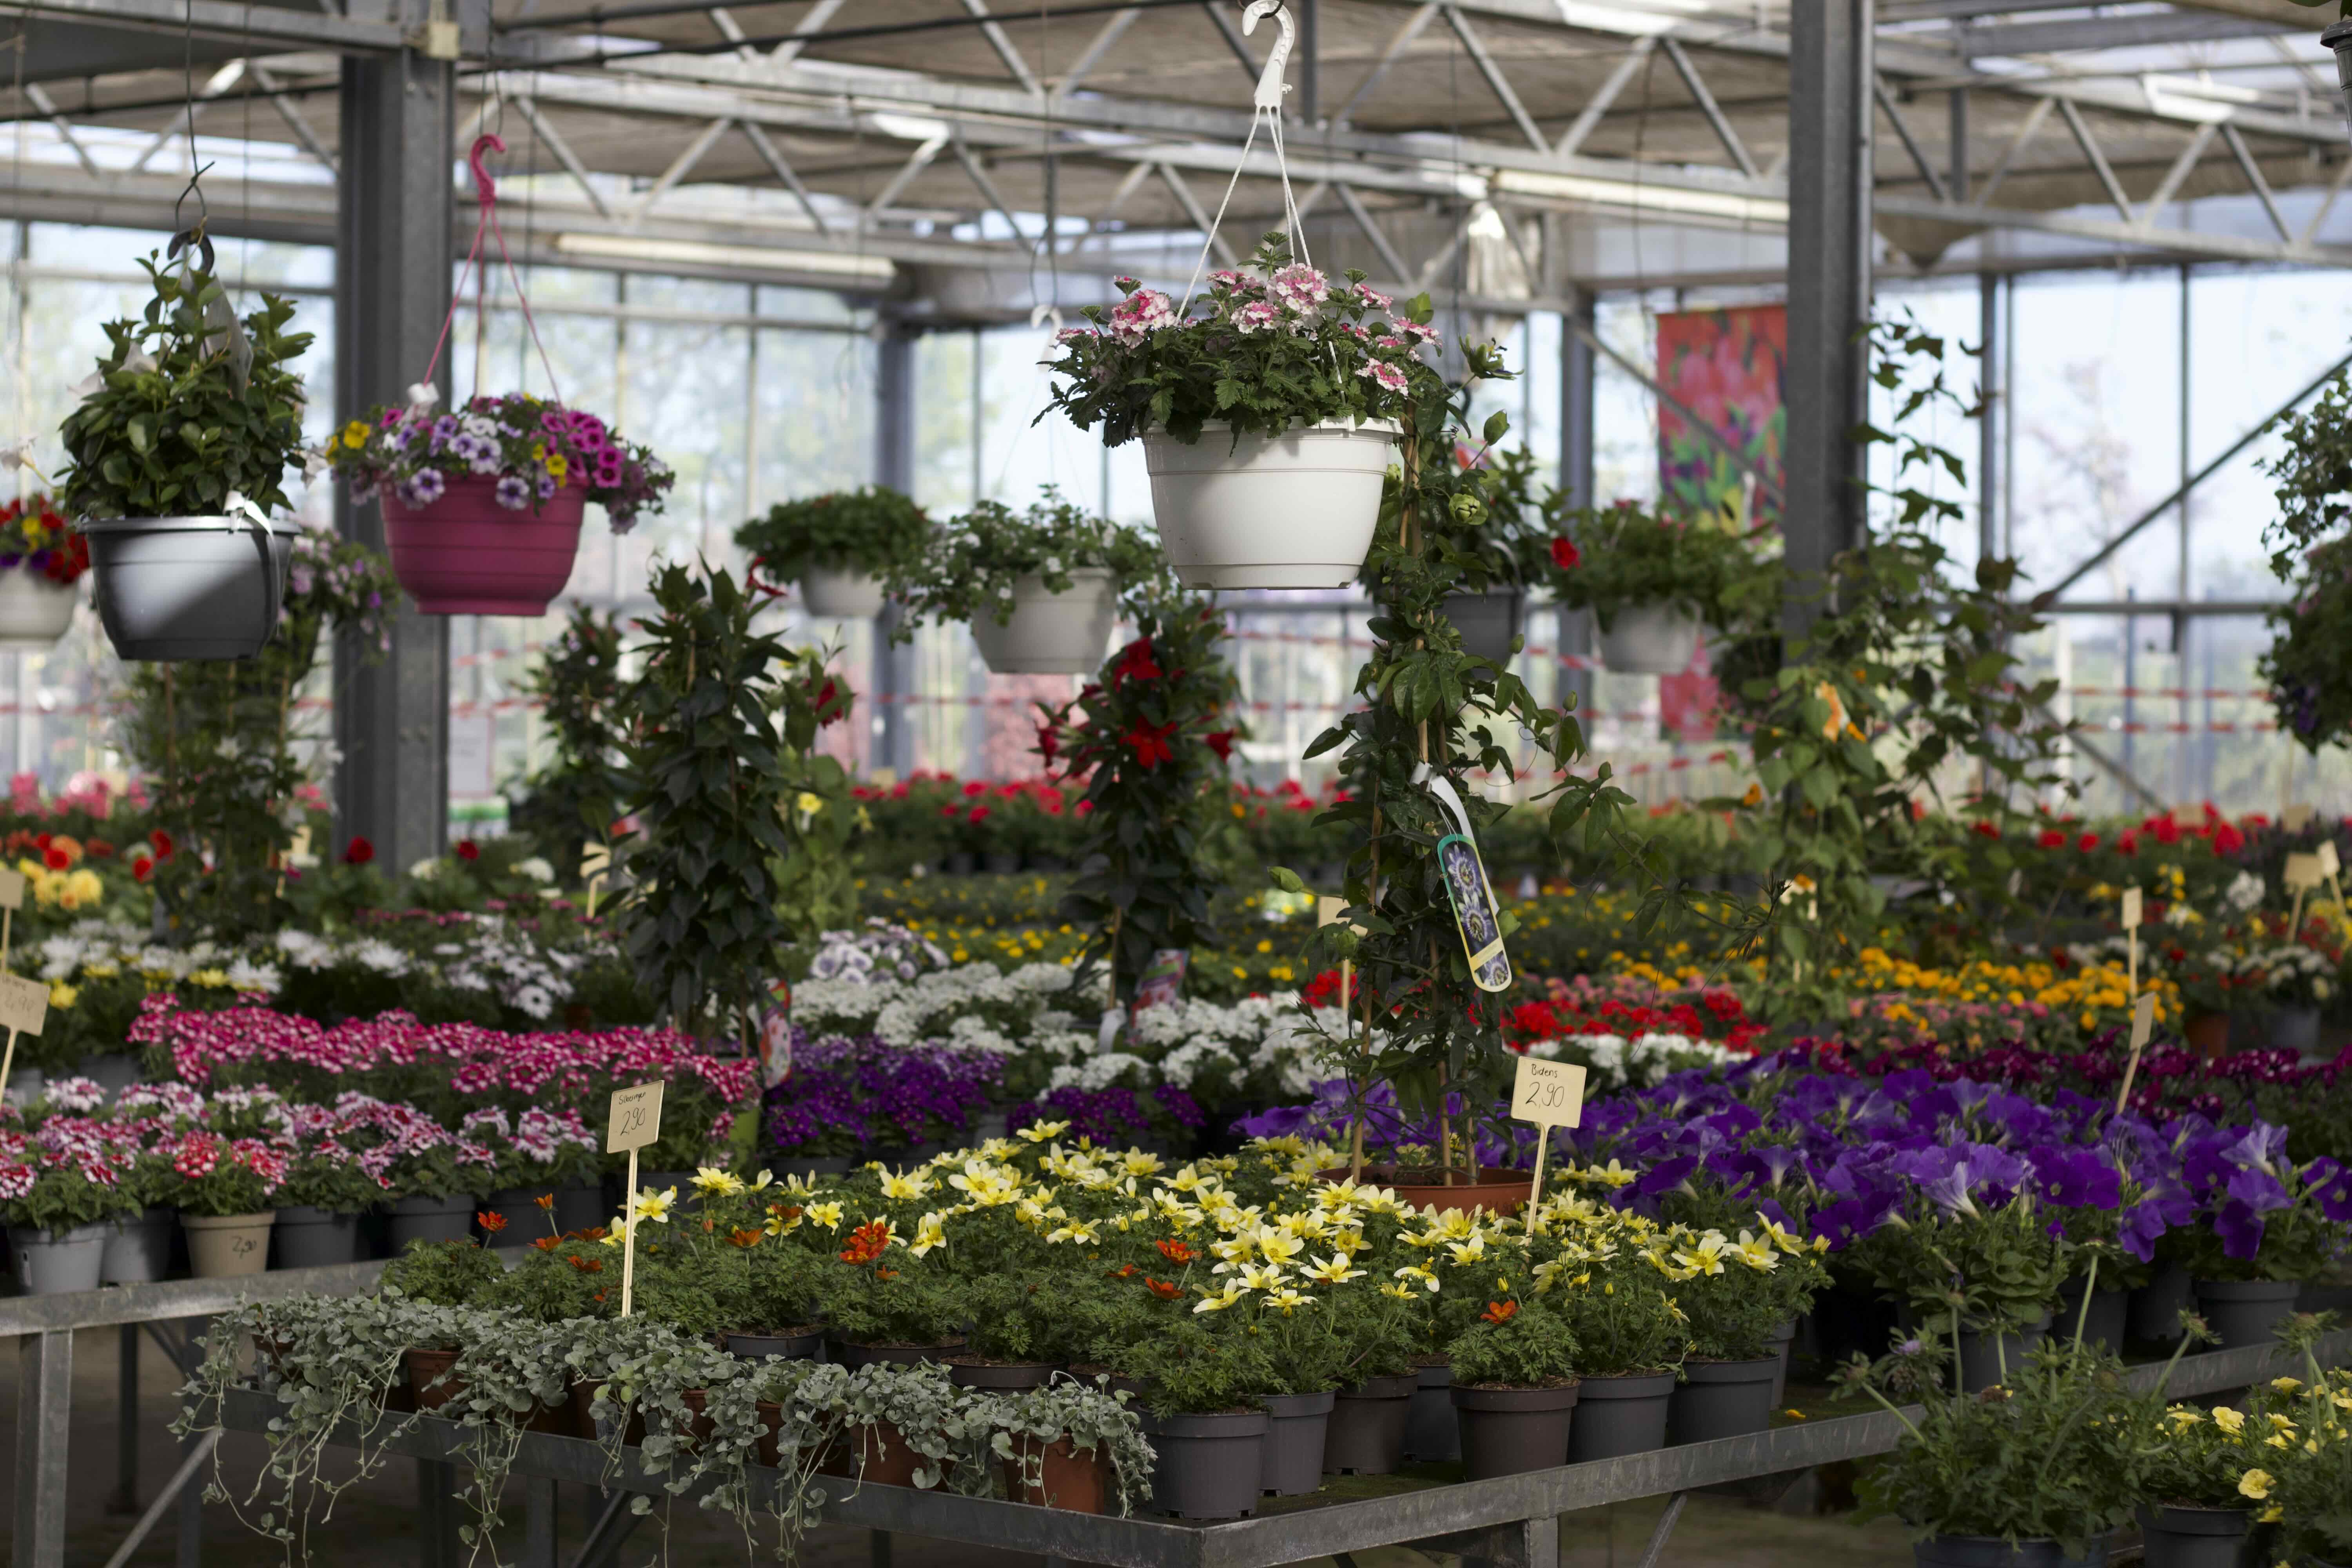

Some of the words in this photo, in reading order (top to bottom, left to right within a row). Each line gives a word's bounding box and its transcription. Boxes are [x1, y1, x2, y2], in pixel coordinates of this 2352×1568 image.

[1531, 1063, 1558, 1078] Bidens
[1525, 1082, 1564, 1109] 2,90
[620, 1107, 646, 1136] 2,90
